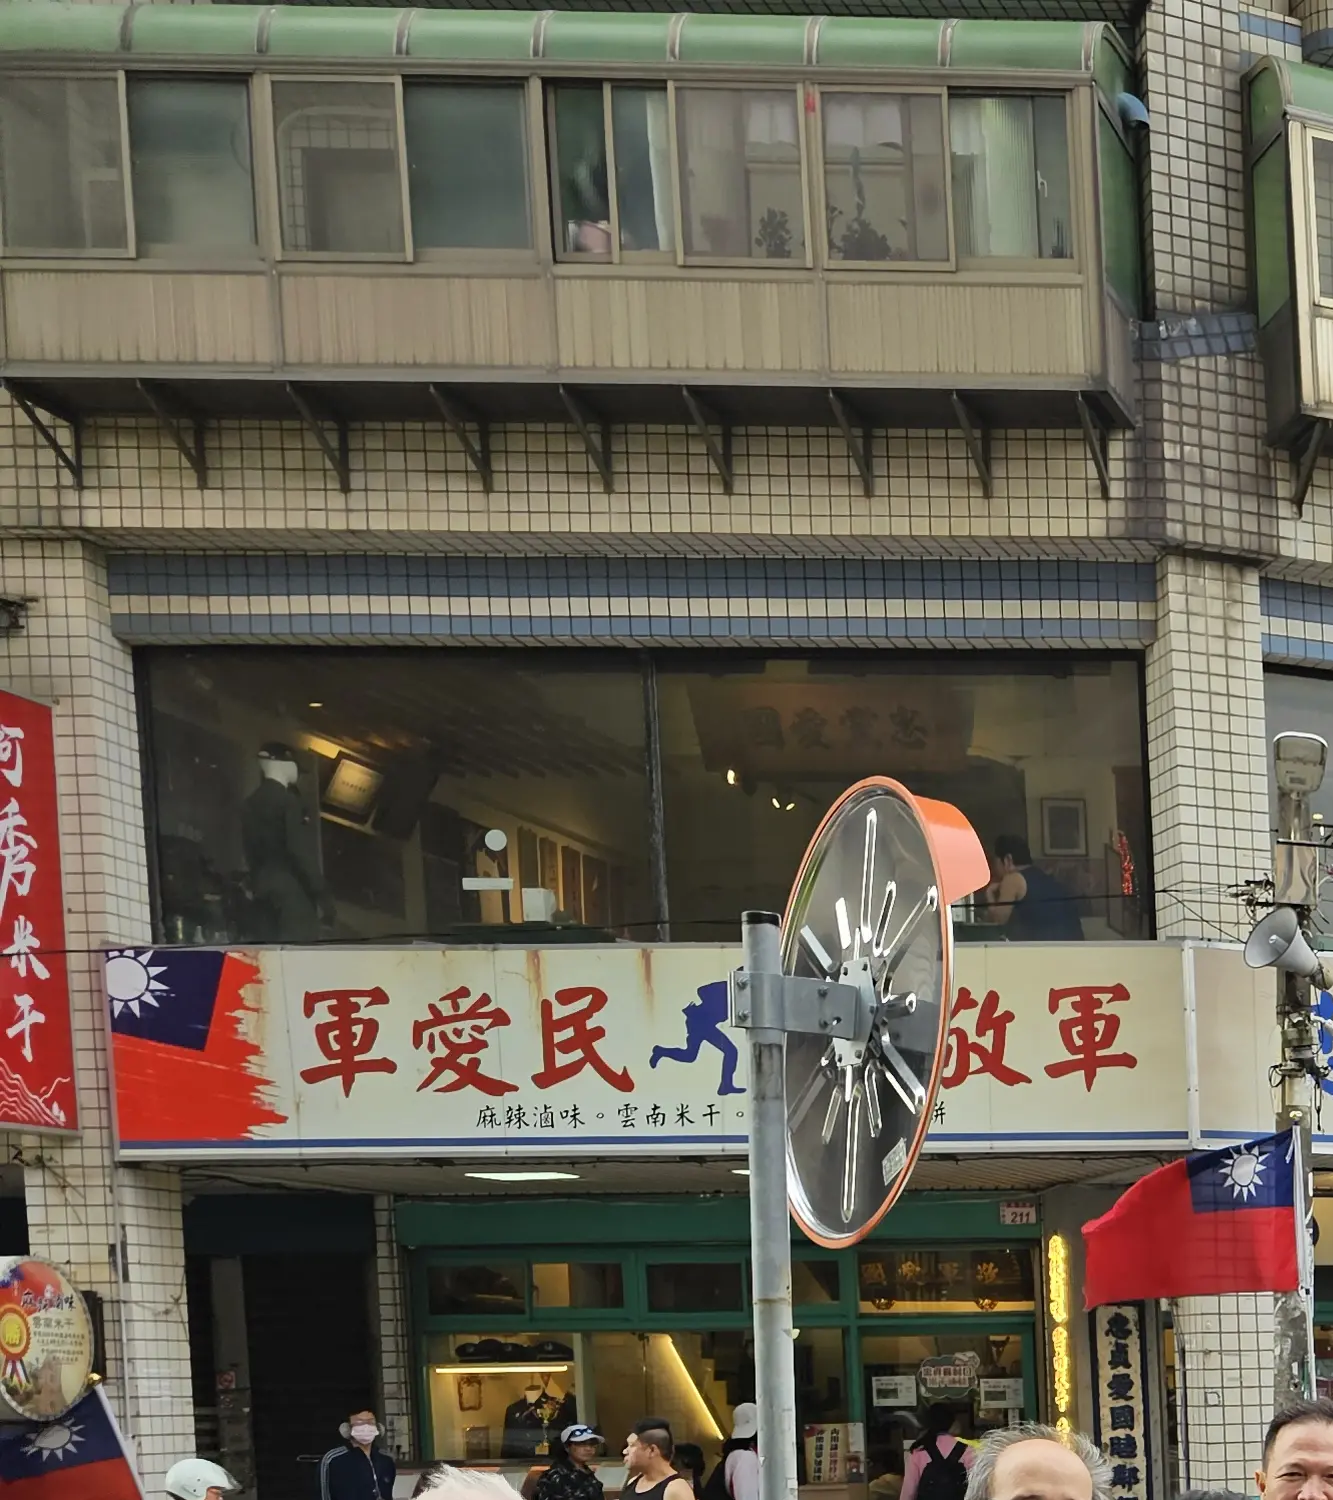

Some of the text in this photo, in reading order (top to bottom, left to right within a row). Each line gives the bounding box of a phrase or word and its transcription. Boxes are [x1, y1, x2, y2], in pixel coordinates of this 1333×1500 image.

[300, 986, 635, 1098] 軍愛民
[1010, 1211, 1031, 1224] 211
